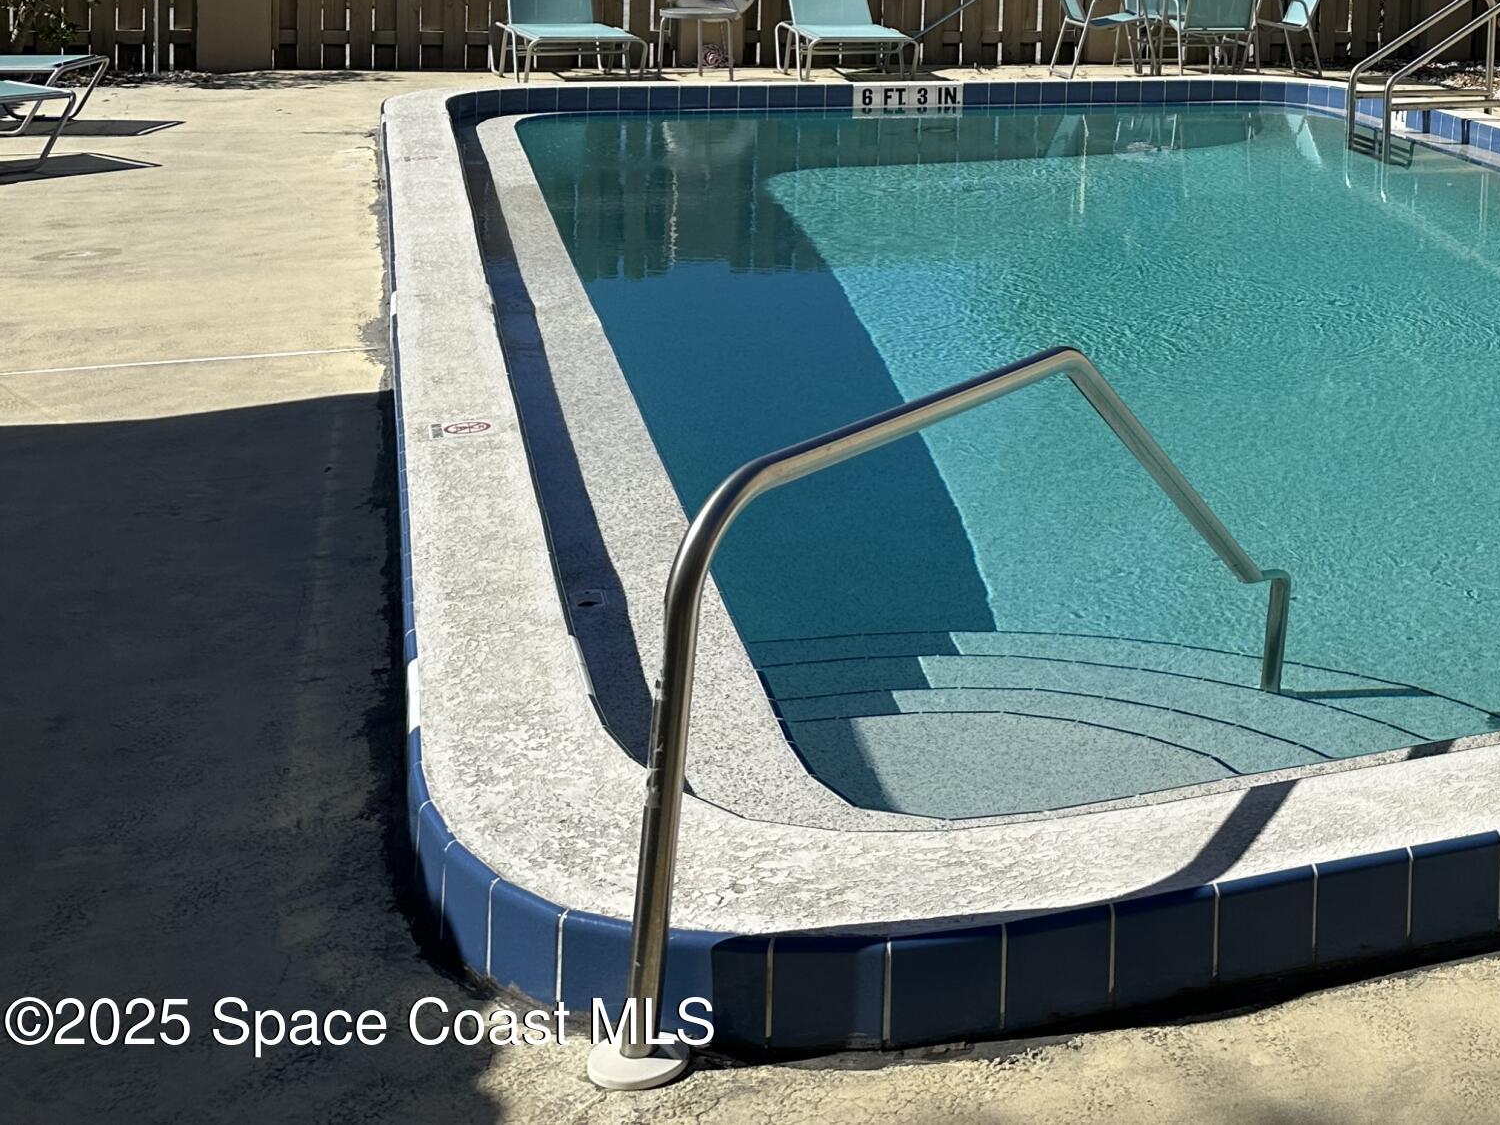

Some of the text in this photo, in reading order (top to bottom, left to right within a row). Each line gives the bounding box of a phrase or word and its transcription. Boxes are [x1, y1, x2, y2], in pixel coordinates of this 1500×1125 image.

[862, 87, 960, 106] 6 FT. 3 IN.
